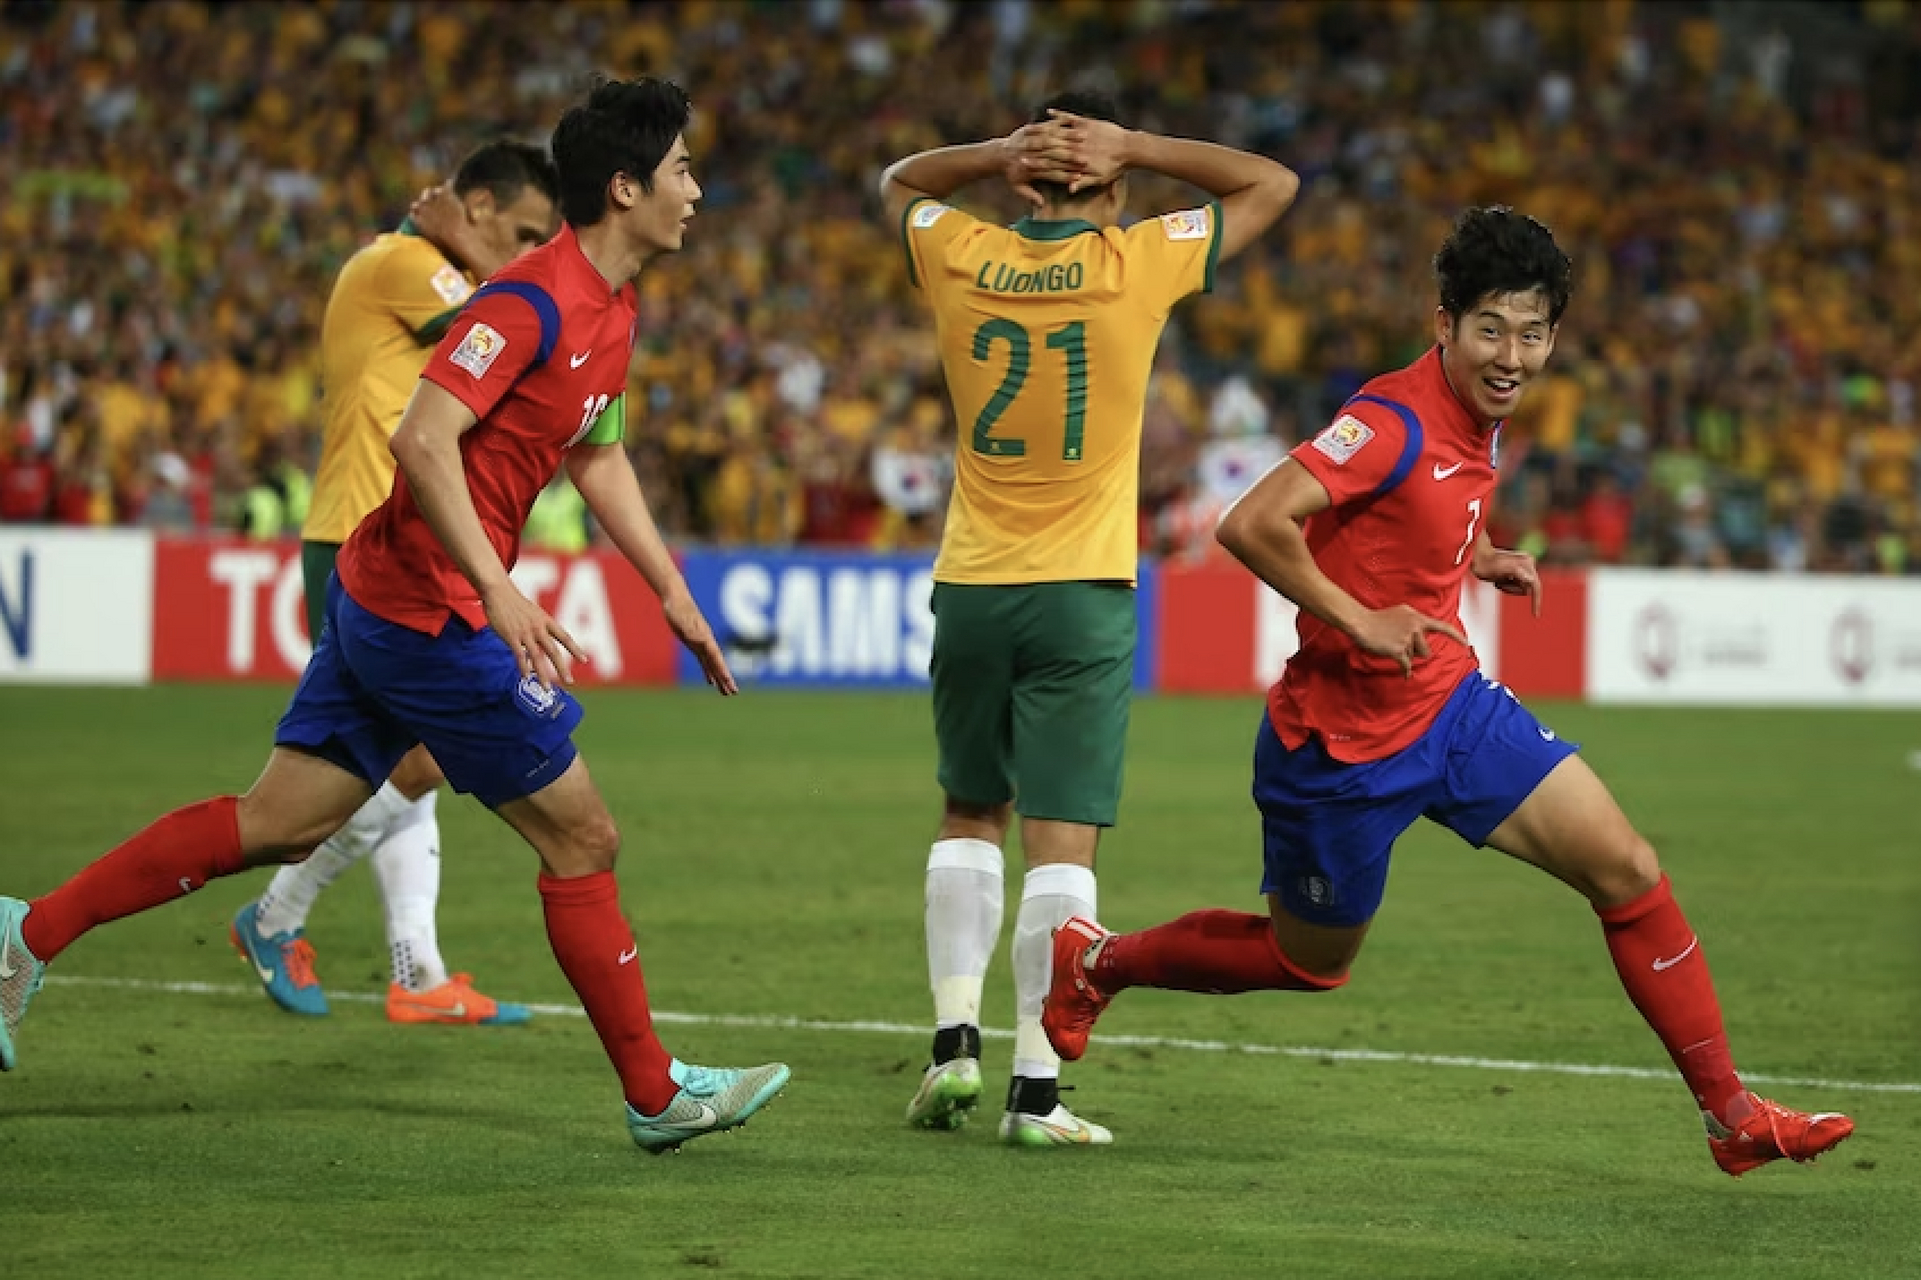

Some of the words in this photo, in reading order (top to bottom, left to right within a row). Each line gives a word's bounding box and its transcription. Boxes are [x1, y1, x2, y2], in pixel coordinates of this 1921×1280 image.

[975, 260, 1084, 293] LUONGO
[971, 318, 1088, 460] 21
[1454, 498, 1482, 566] 7
